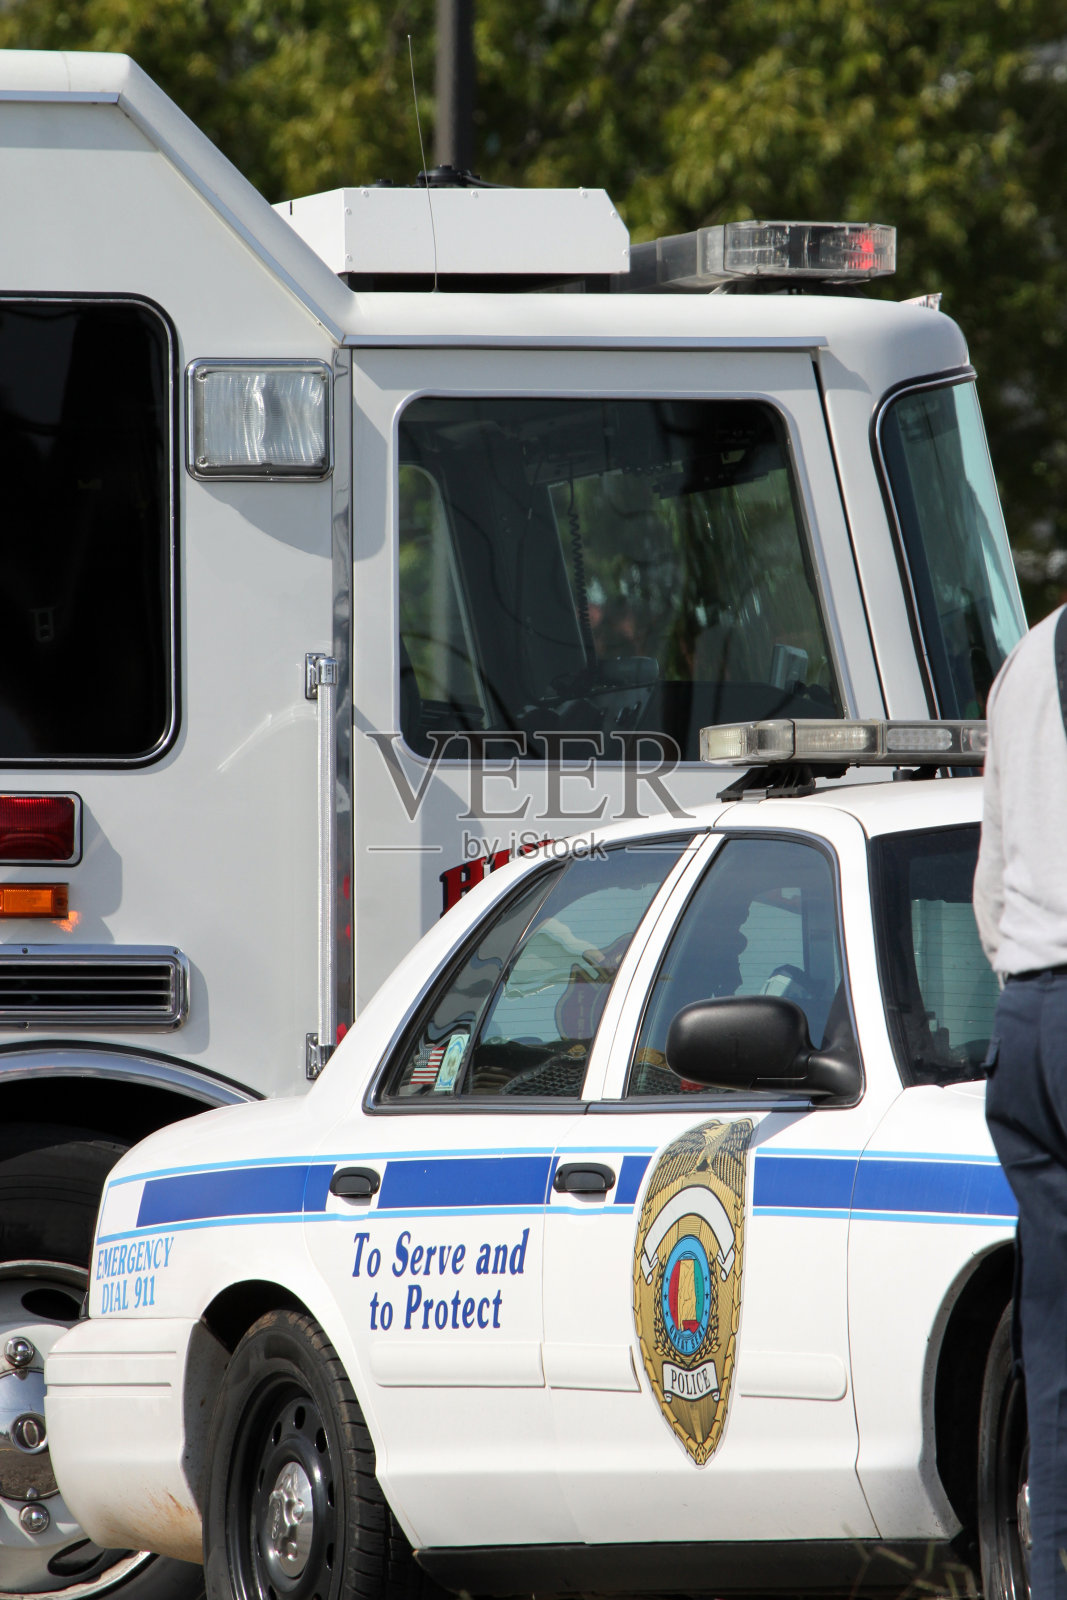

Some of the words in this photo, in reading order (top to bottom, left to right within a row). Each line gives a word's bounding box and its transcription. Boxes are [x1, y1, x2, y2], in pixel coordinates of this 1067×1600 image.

[96, 1236, 174, 1281] EMERGENCY
[352, 1232, 382, 1278] To
[391, 1230, 466, 1278] Serve
[475, 1227, 531, 1275] and
[101, 1279, 129, 1314] DIAL
[134, 1275, 155, 1308] 911
[369, 1291, 394, 1331] to
[403, 1284, 503, 1330] Protect
[671, 1368, 711, 1395] POLICE
